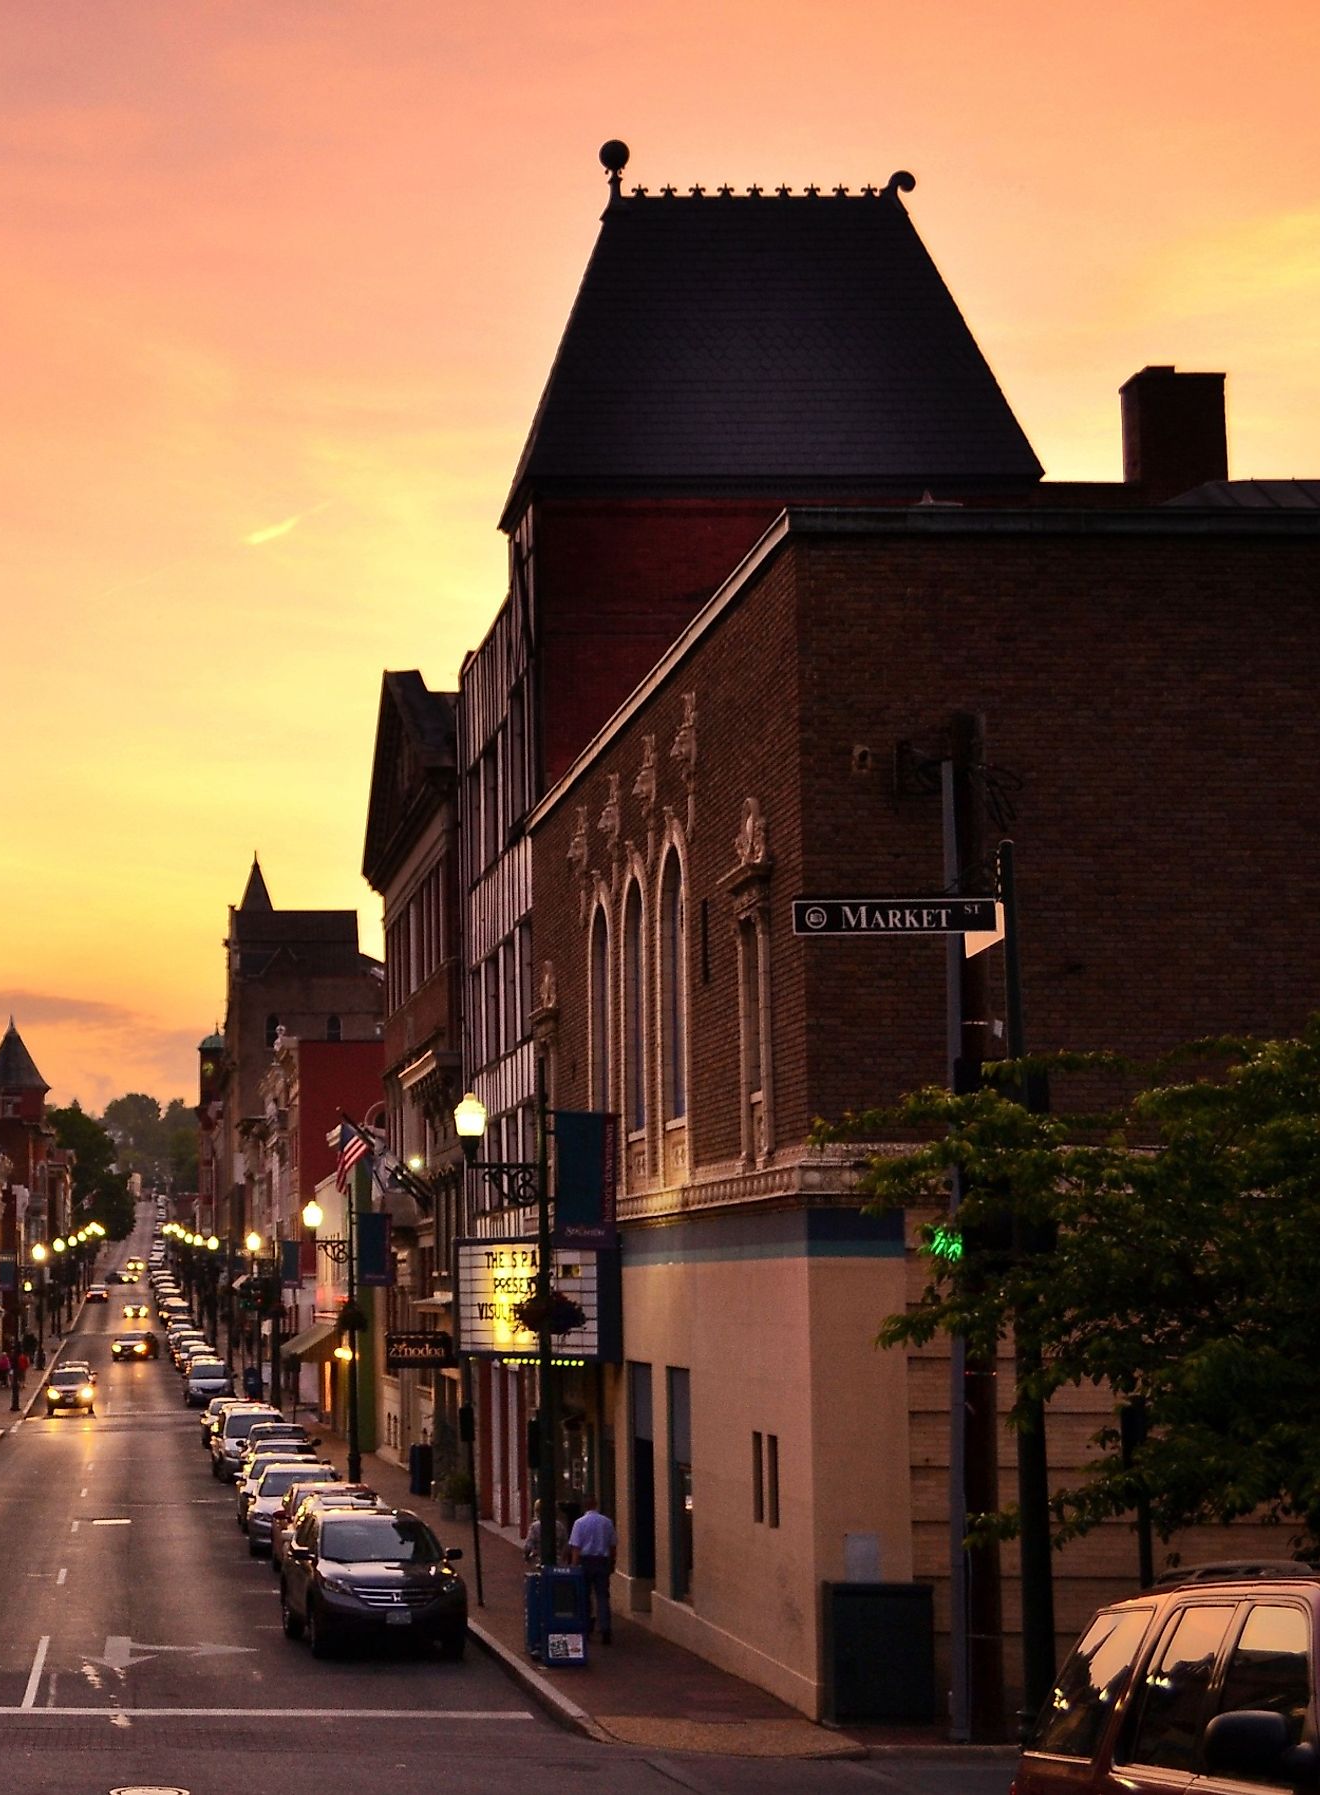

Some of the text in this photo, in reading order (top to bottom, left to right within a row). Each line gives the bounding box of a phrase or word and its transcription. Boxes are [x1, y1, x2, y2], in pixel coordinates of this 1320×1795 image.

[841, 904, 981, 929] MARKET ST
[484, 1250, 505, 1269] THE
